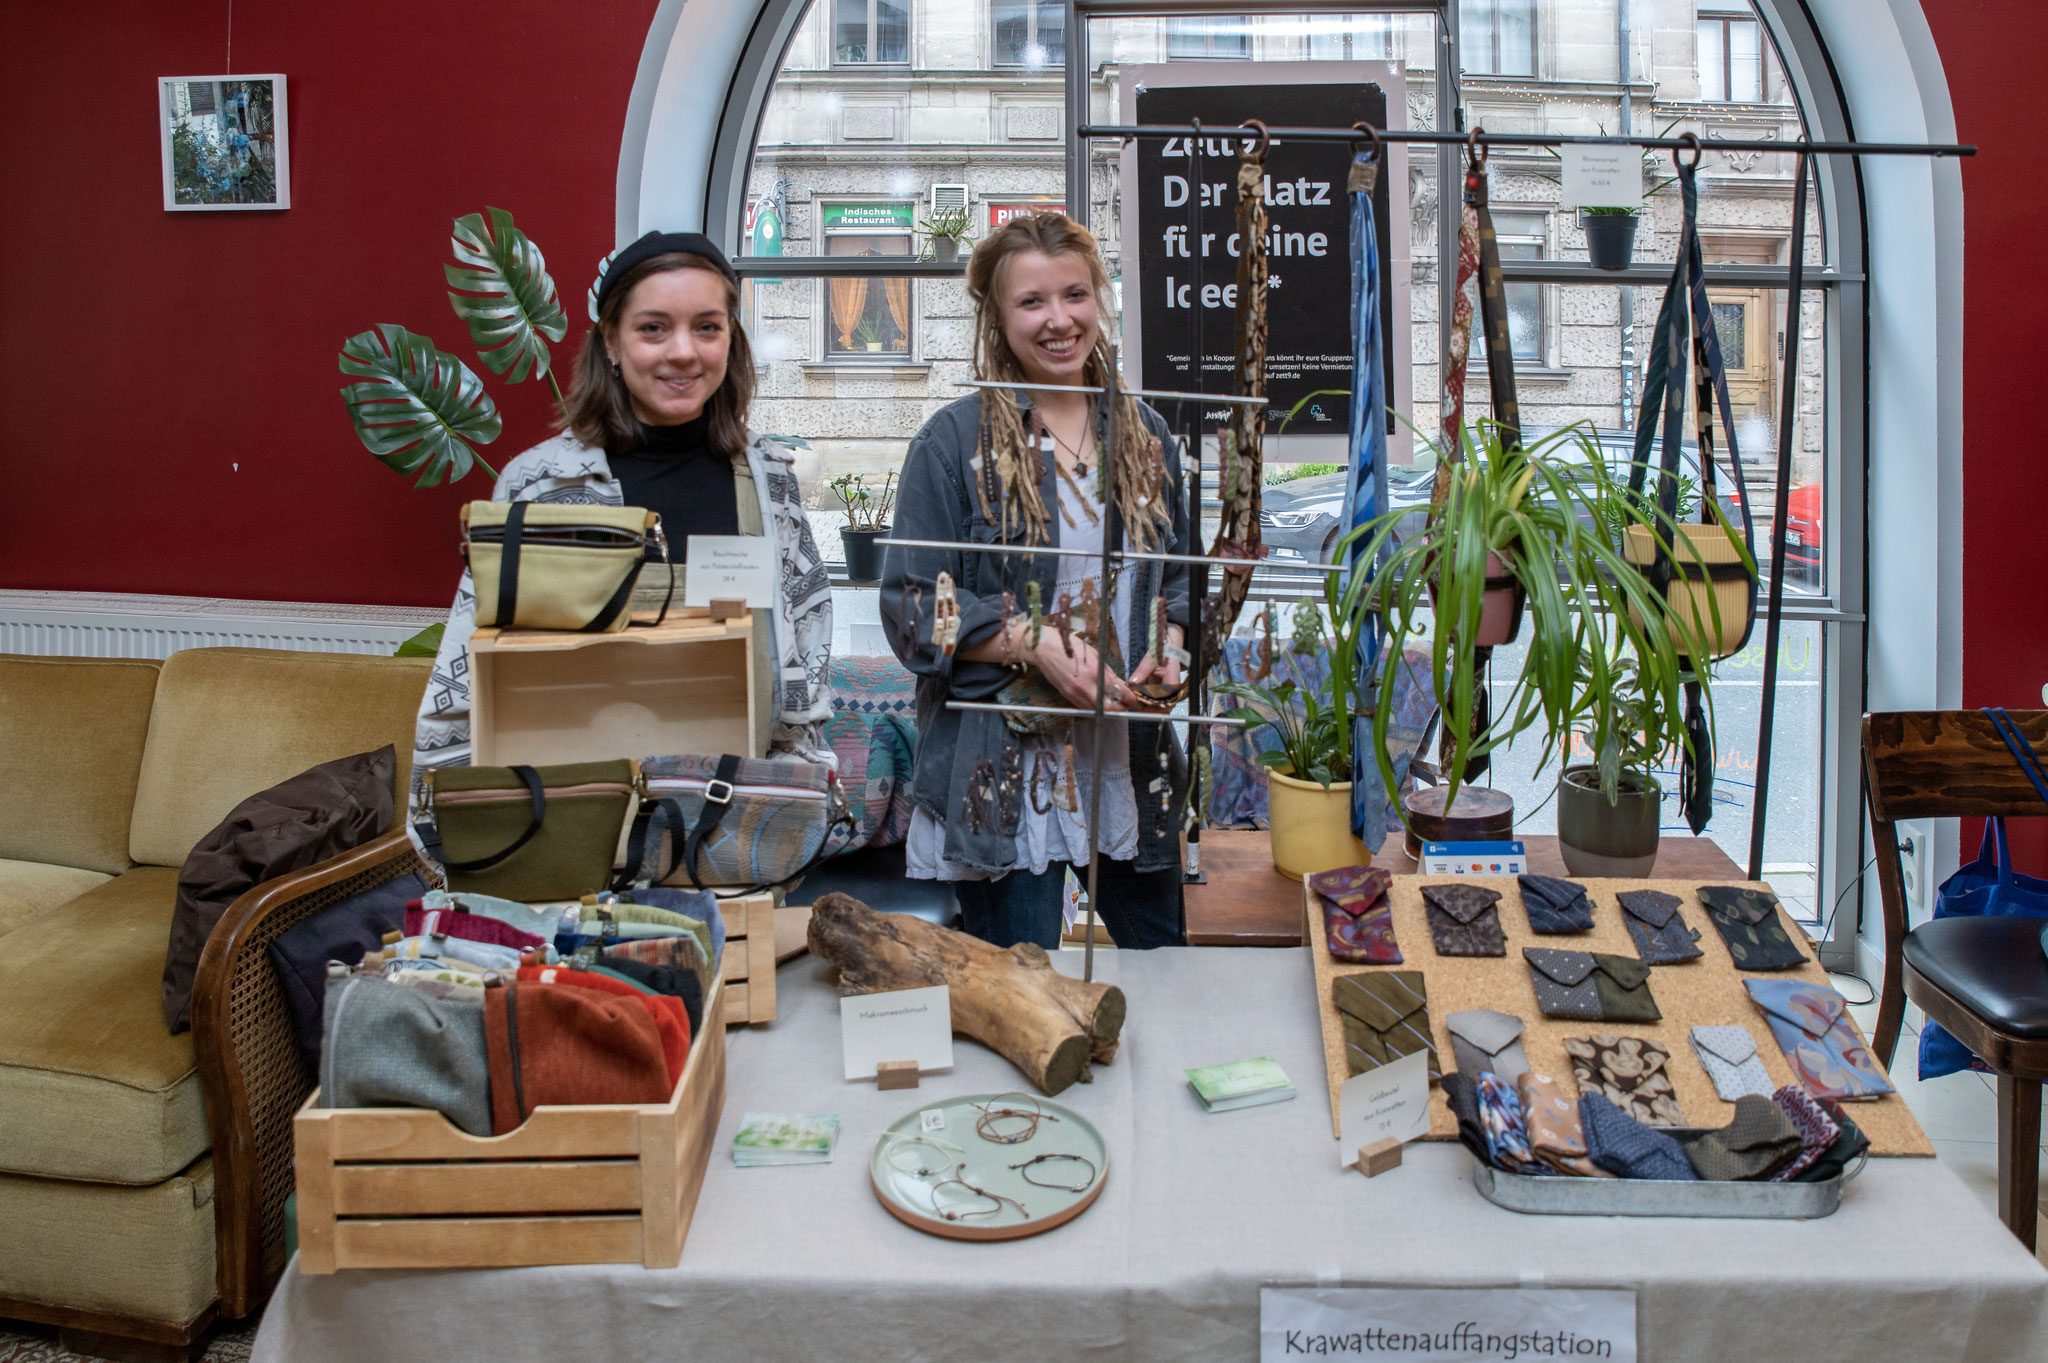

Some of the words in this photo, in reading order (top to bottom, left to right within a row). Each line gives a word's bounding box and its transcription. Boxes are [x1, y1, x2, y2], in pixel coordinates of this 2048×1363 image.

[1163, 175, 1228, 208] Der
[1263, 174, 1332, 207] latz
[844, 208, 892, 216] Indisches
[841, 216, 896, 224] Restaurant
[1276, 354, 1294, 362] könnt
[1295, 354, 1305, 362] ihr
[1176, 363, 1189, 371] und
[1269, 363, 1301, 371] umsetzen!
[1302, 363, 1320, 371] Keine
[1264, 372, 1275, 380] auf
[1275, 372, 1301, 380] zett9.de
[1285, 1321, 1612, 1360] Krawattenauffangstation
